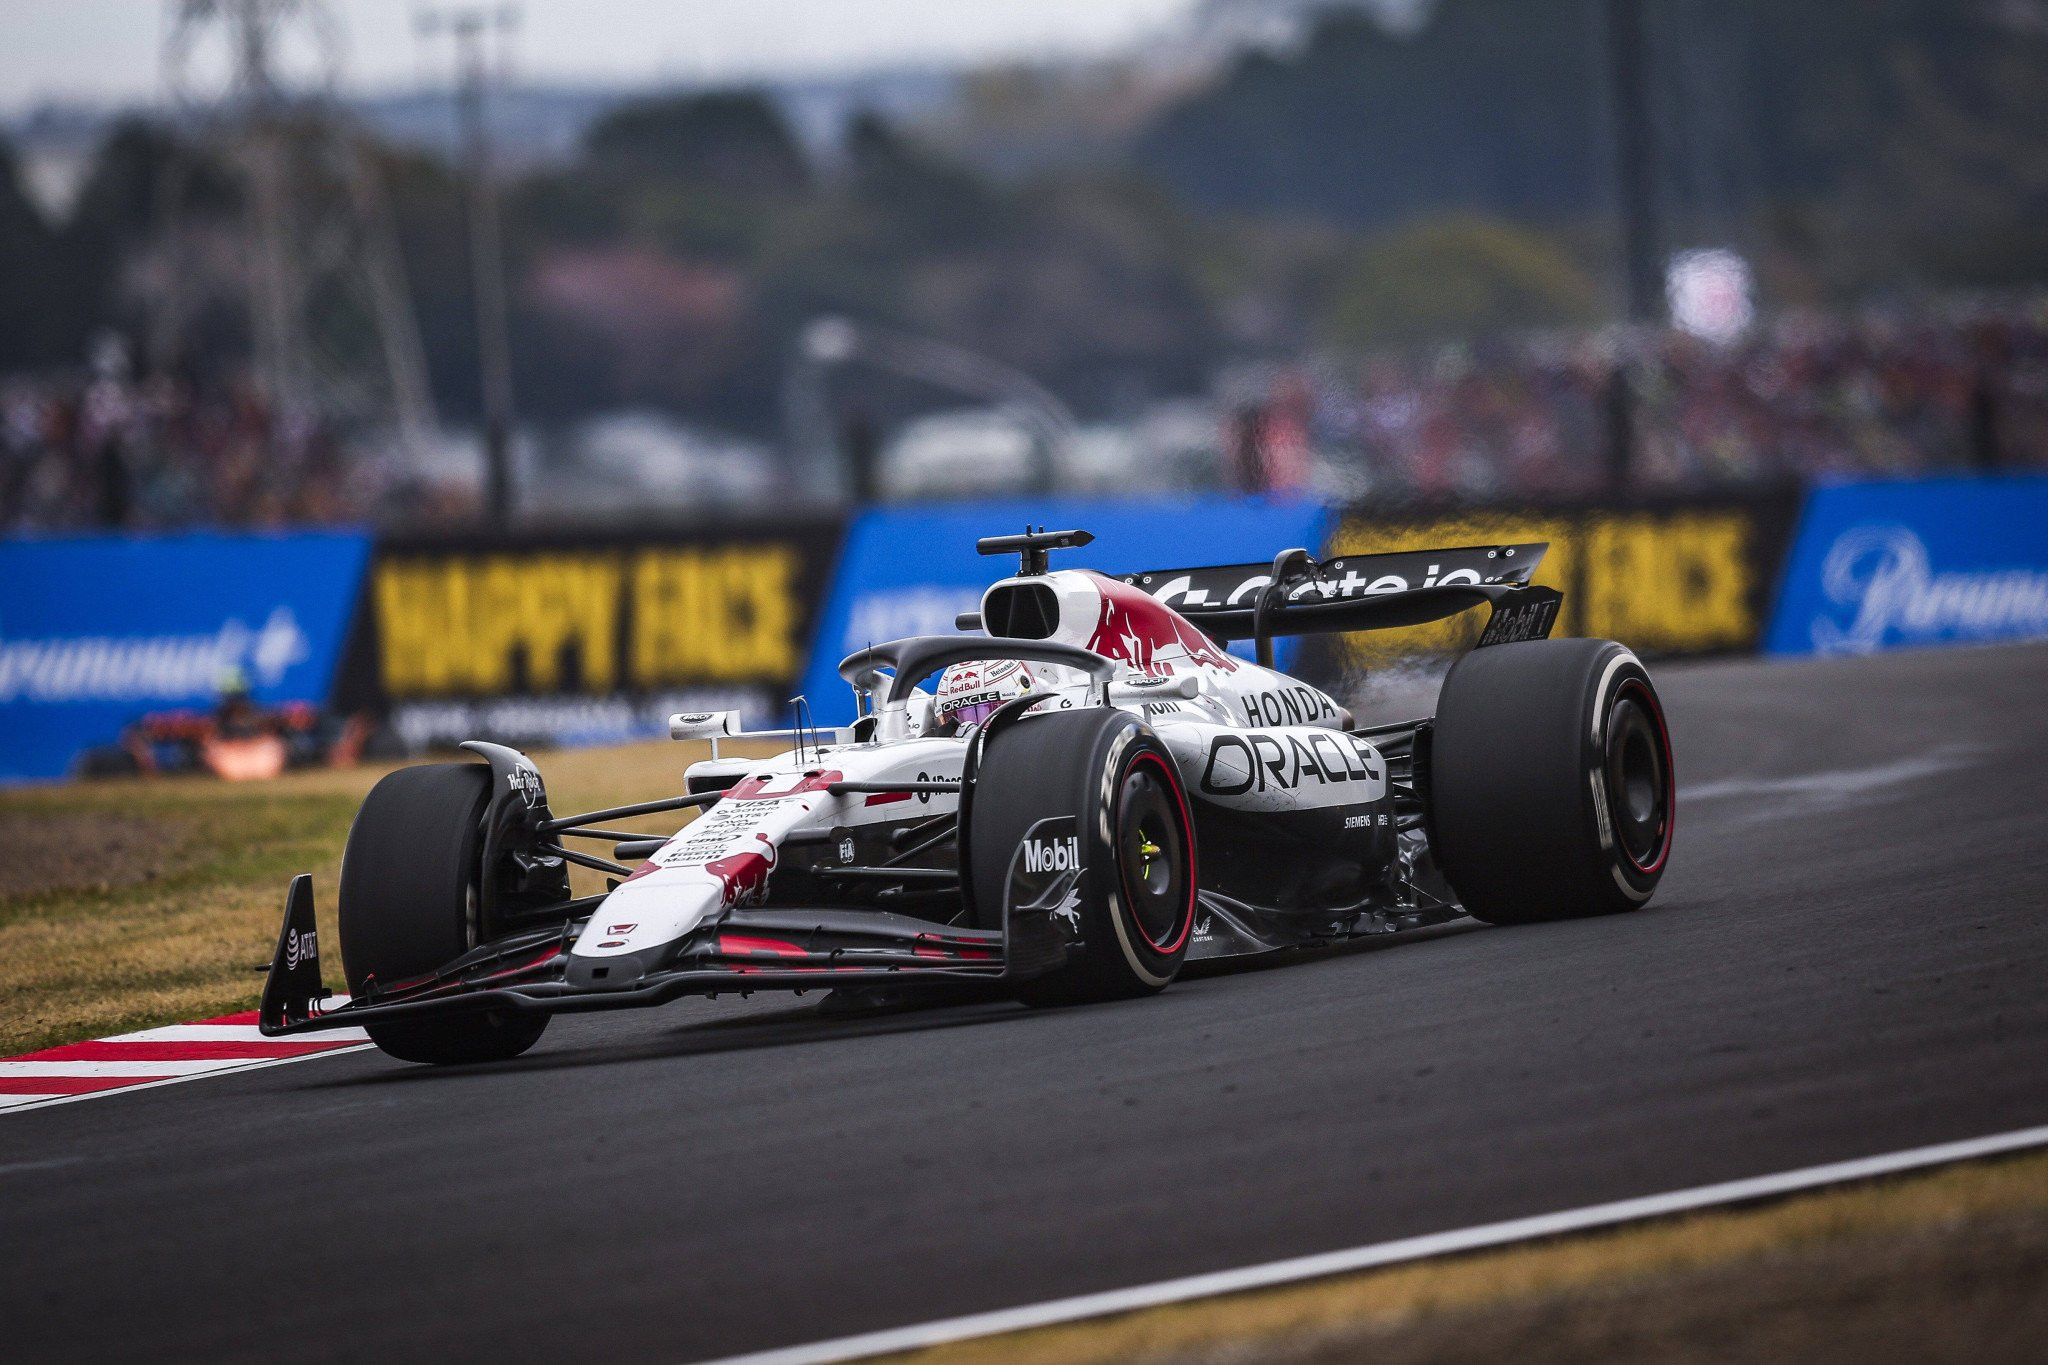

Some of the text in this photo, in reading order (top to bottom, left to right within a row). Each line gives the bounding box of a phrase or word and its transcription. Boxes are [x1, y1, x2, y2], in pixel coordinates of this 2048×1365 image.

[950, 680, 980, 694] Red Bull
[943, 693, 998, 712] ORACLE
[1241, 686, 1336, 728] HONDA
[1200, 734, 1380, 796] ORACLE
[735, 800, 780, 808] VISA
[1344, 814, 1371, 829] SIEMENS
[1023, 836, 1080, 873] Mobil
[300, 931, 317, 960] AT&T
